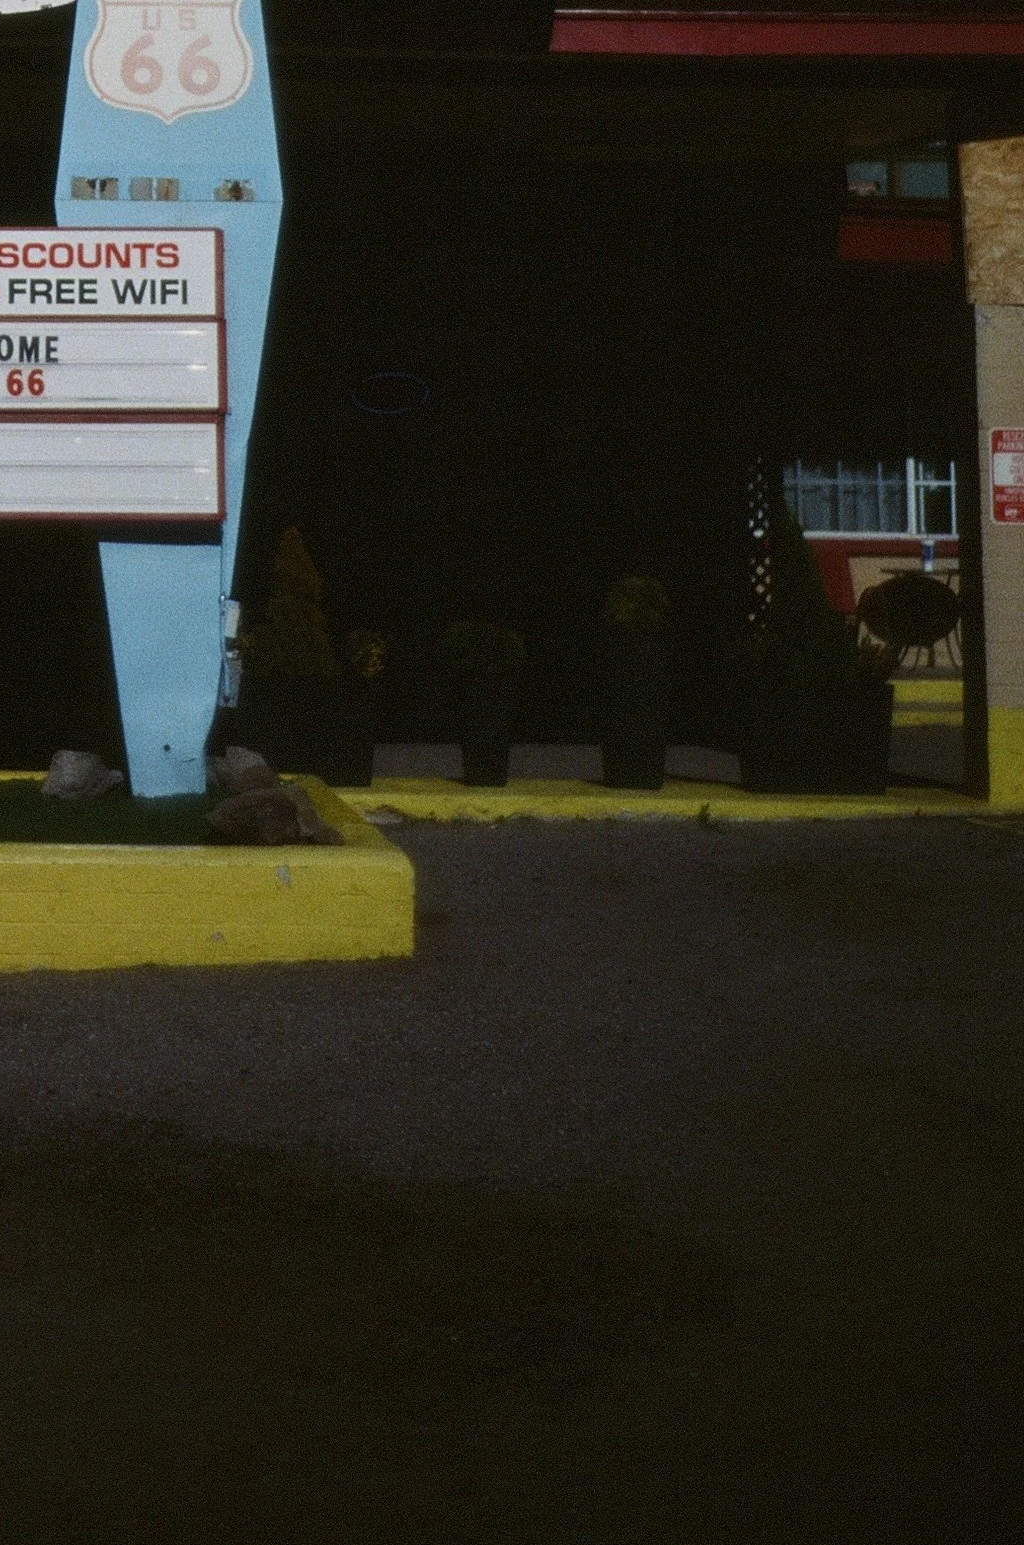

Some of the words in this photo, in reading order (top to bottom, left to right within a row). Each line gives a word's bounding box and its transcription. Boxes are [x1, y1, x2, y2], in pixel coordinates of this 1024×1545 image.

[120, 33, 221, 96] 66
[7, 278, 98, 305] FREE
[111, 278, 189, 305] WIFI
[5, 368, 45, 396] 66
